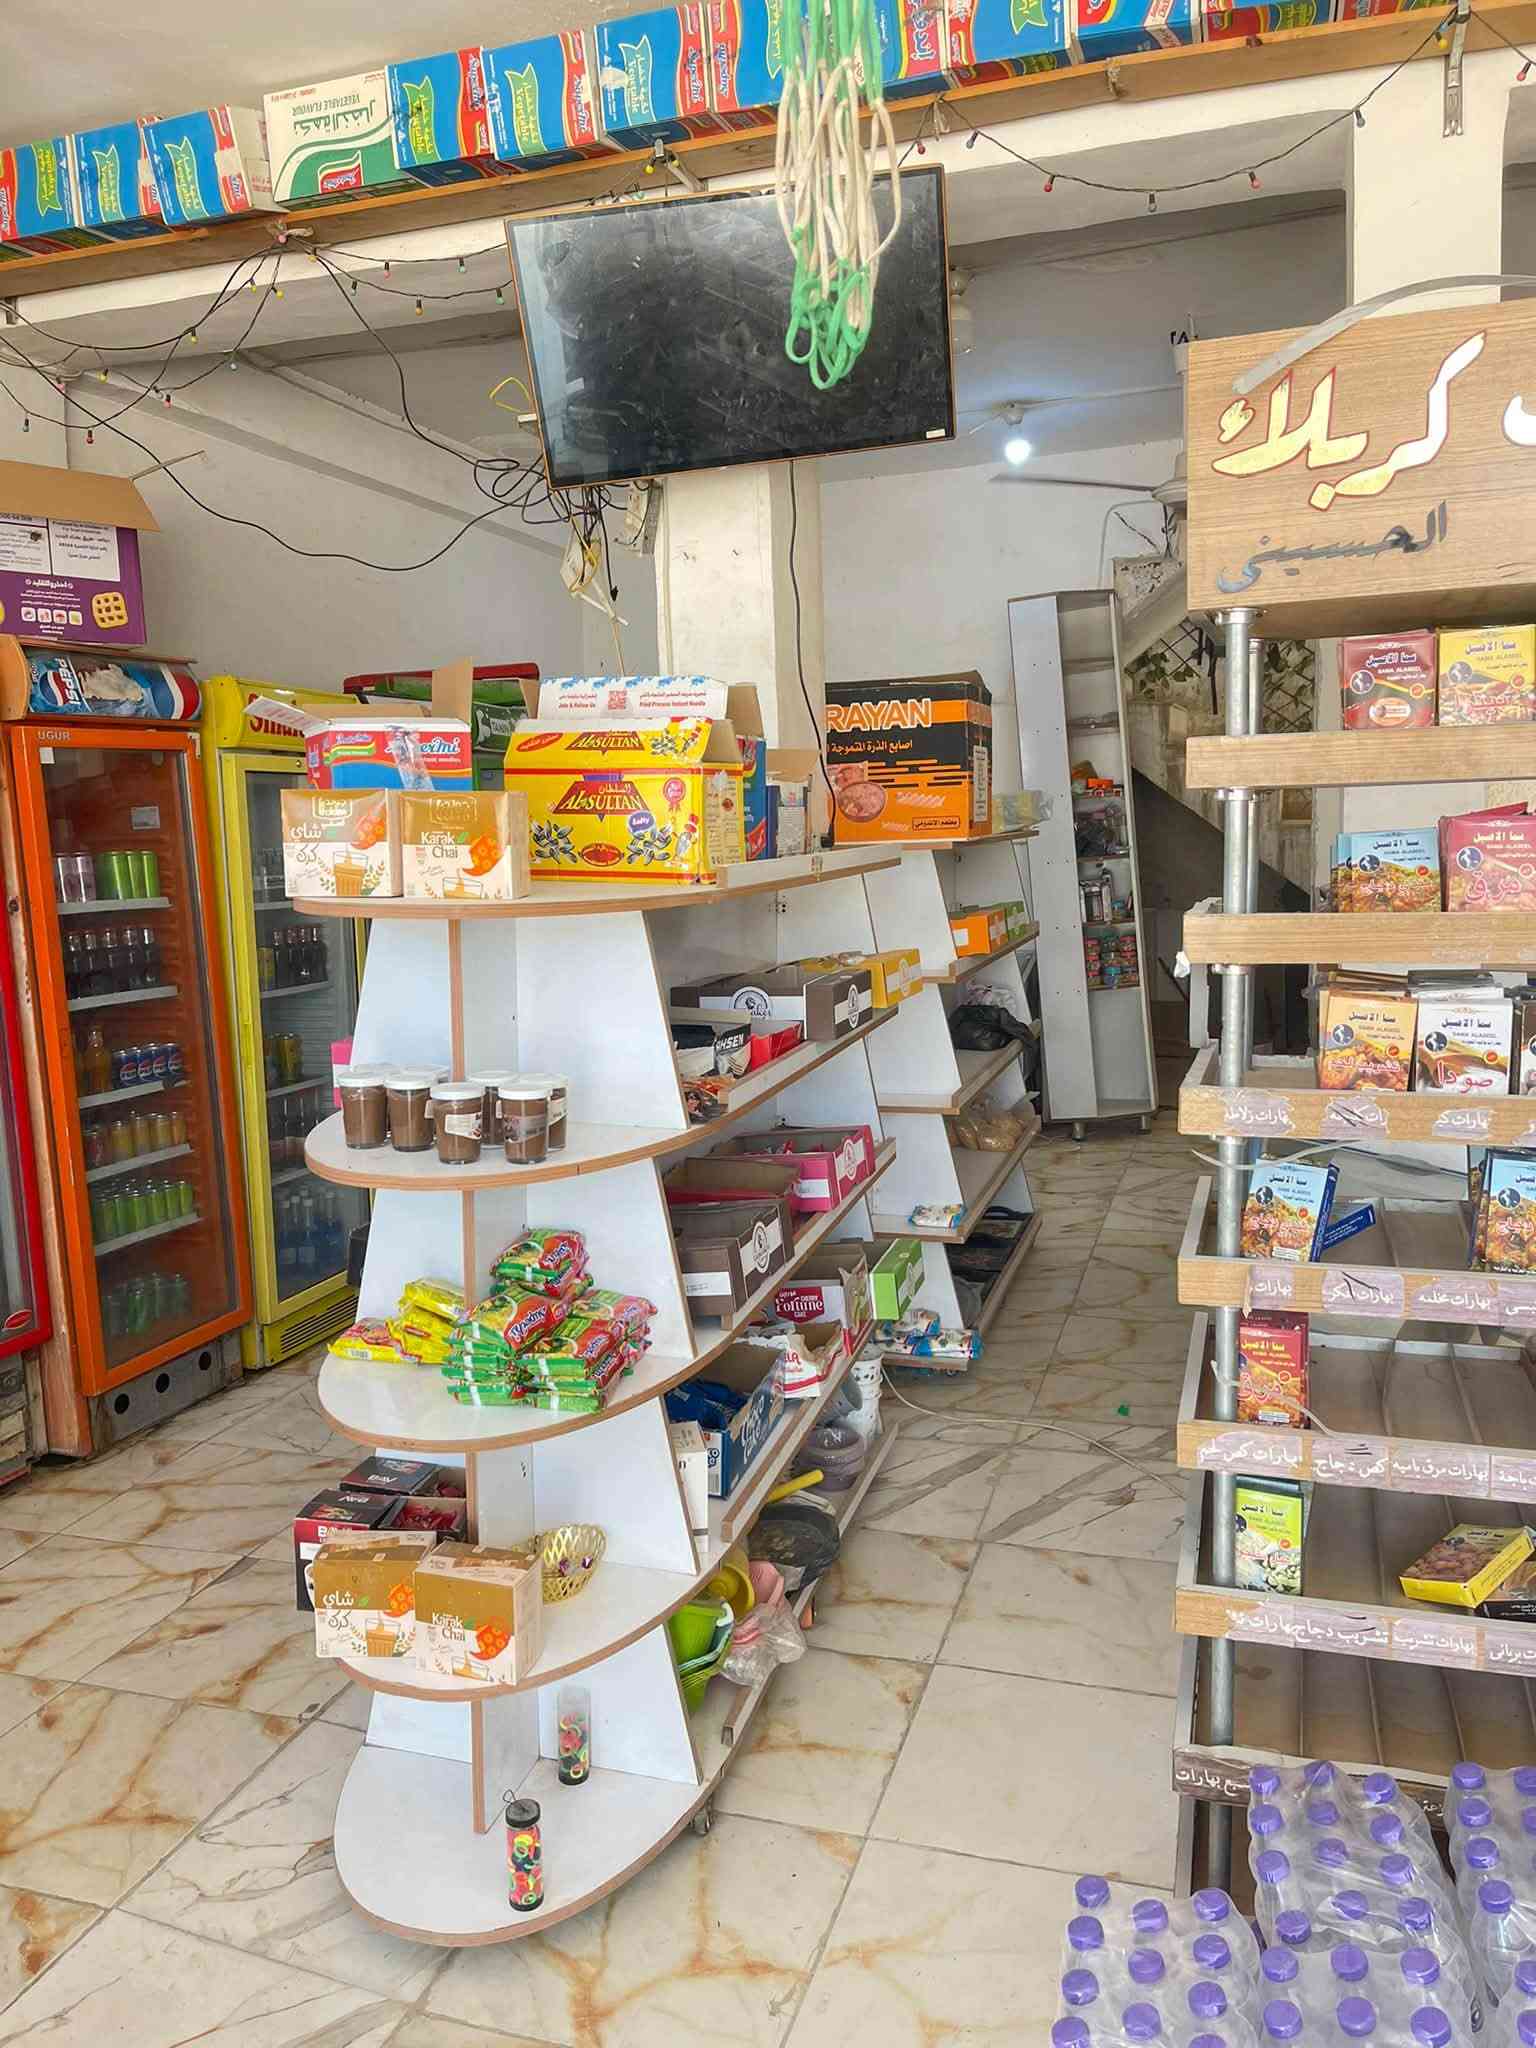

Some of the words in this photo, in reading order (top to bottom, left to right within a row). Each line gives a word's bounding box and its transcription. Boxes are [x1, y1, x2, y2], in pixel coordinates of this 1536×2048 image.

[54, 657, 82, 705] PEPSI
[825, 698, 933, 733] RAYAN
[37, 731, 71, 741] UGUR
[290, 822, 322, 842] شاي
[421, 831, 456, 845] Karak
[432, 846, 459, 858] Chai
[1436, 1059, 1493, 1094] صودا
[1255, 1279, 1293, 1297] بهارات
[1357, 1286, 1395, 1305] بهارات
[775, 1296, 823, 1312] Fortune
[1450, 1291, 1491, 1311] بهارات
[1447, 1463, 1489, 1481] بهارات
[323, 1590, 354, 1609] شاي
[328, 1610, 352, 1630] كرك
[432, 1613, 463, 1629] Karak
[442, 1628, 466, 1642] Chai
[1436, 1635, 1478, 1656] بهارات
[1175, 1767, 1221, 1790] بهارات
